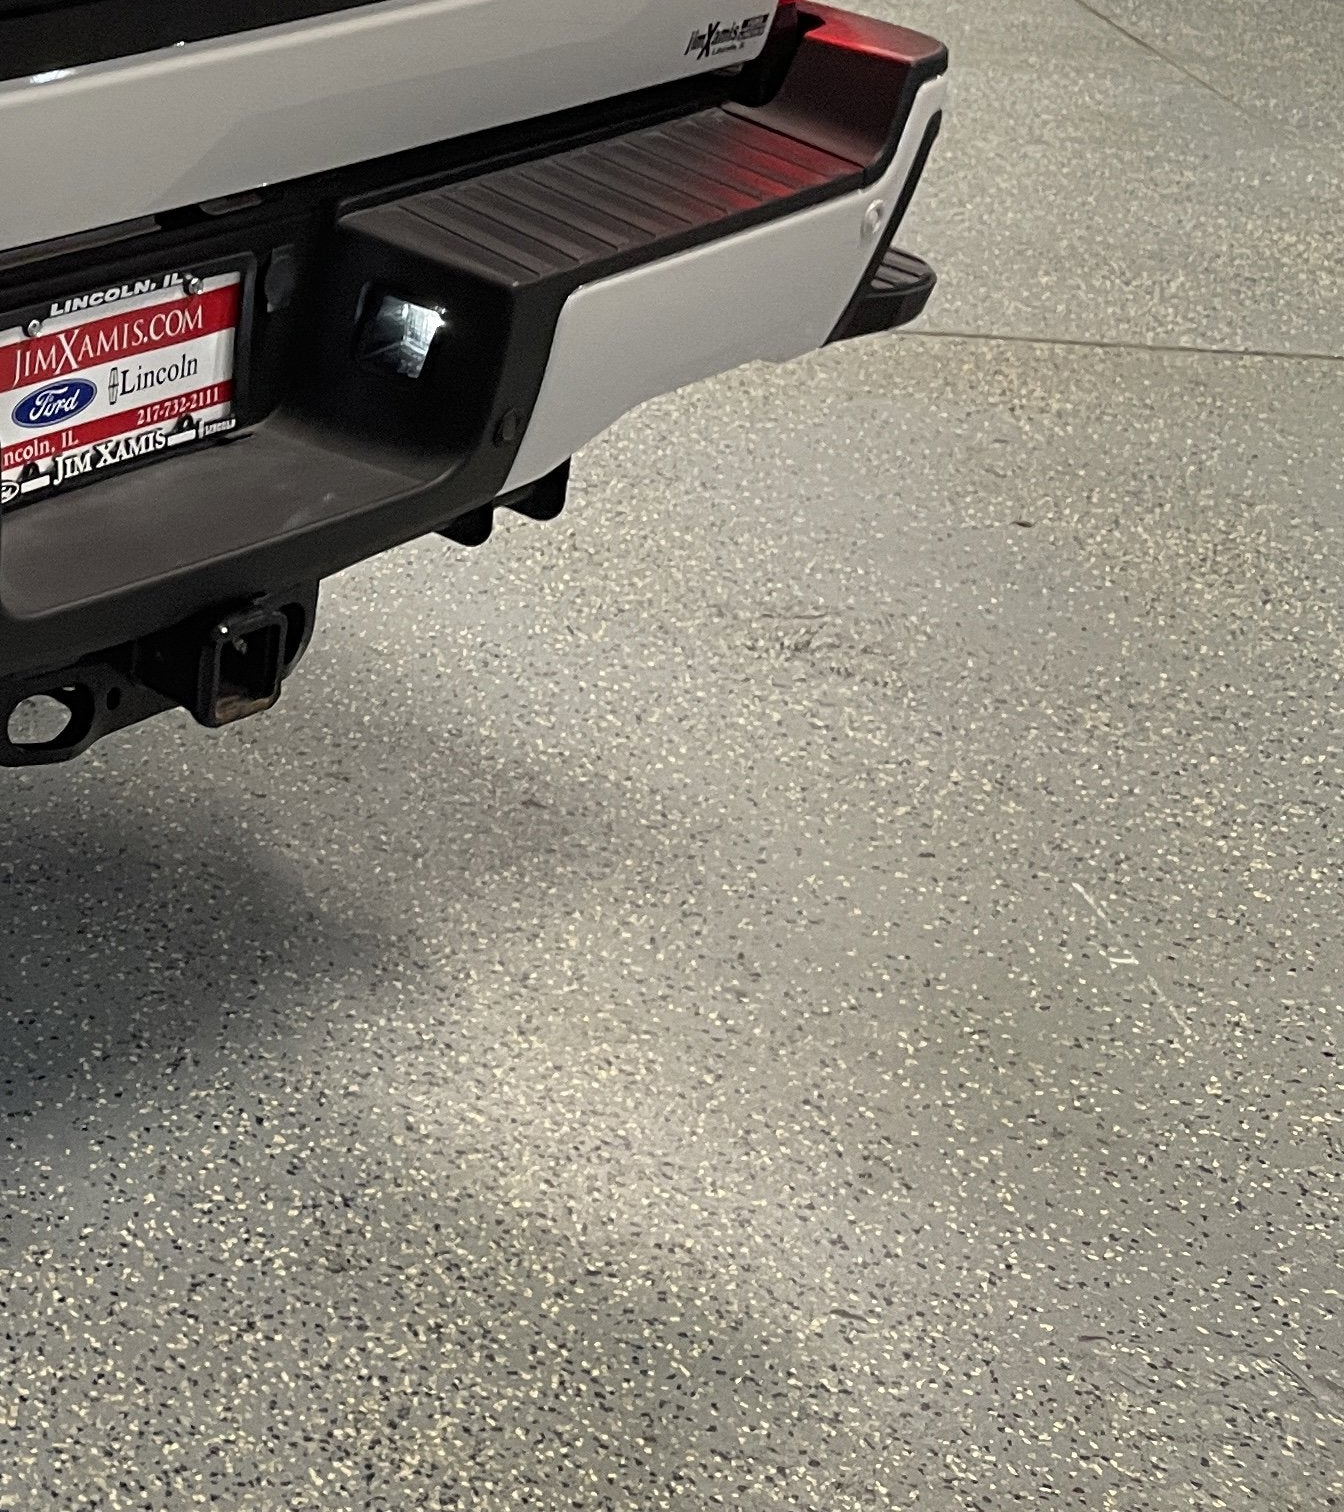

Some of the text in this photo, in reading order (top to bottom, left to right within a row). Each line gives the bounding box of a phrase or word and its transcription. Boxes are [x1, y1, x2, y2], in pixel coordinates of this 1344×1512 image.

[50, 272, 184, 316] LINCOLN, IL
[28, 354, 198, 422] Ford Lincoln
[137, 386, 219, 426] 217-732-2111
[2, 430, 79, 469] ncoln, IL
